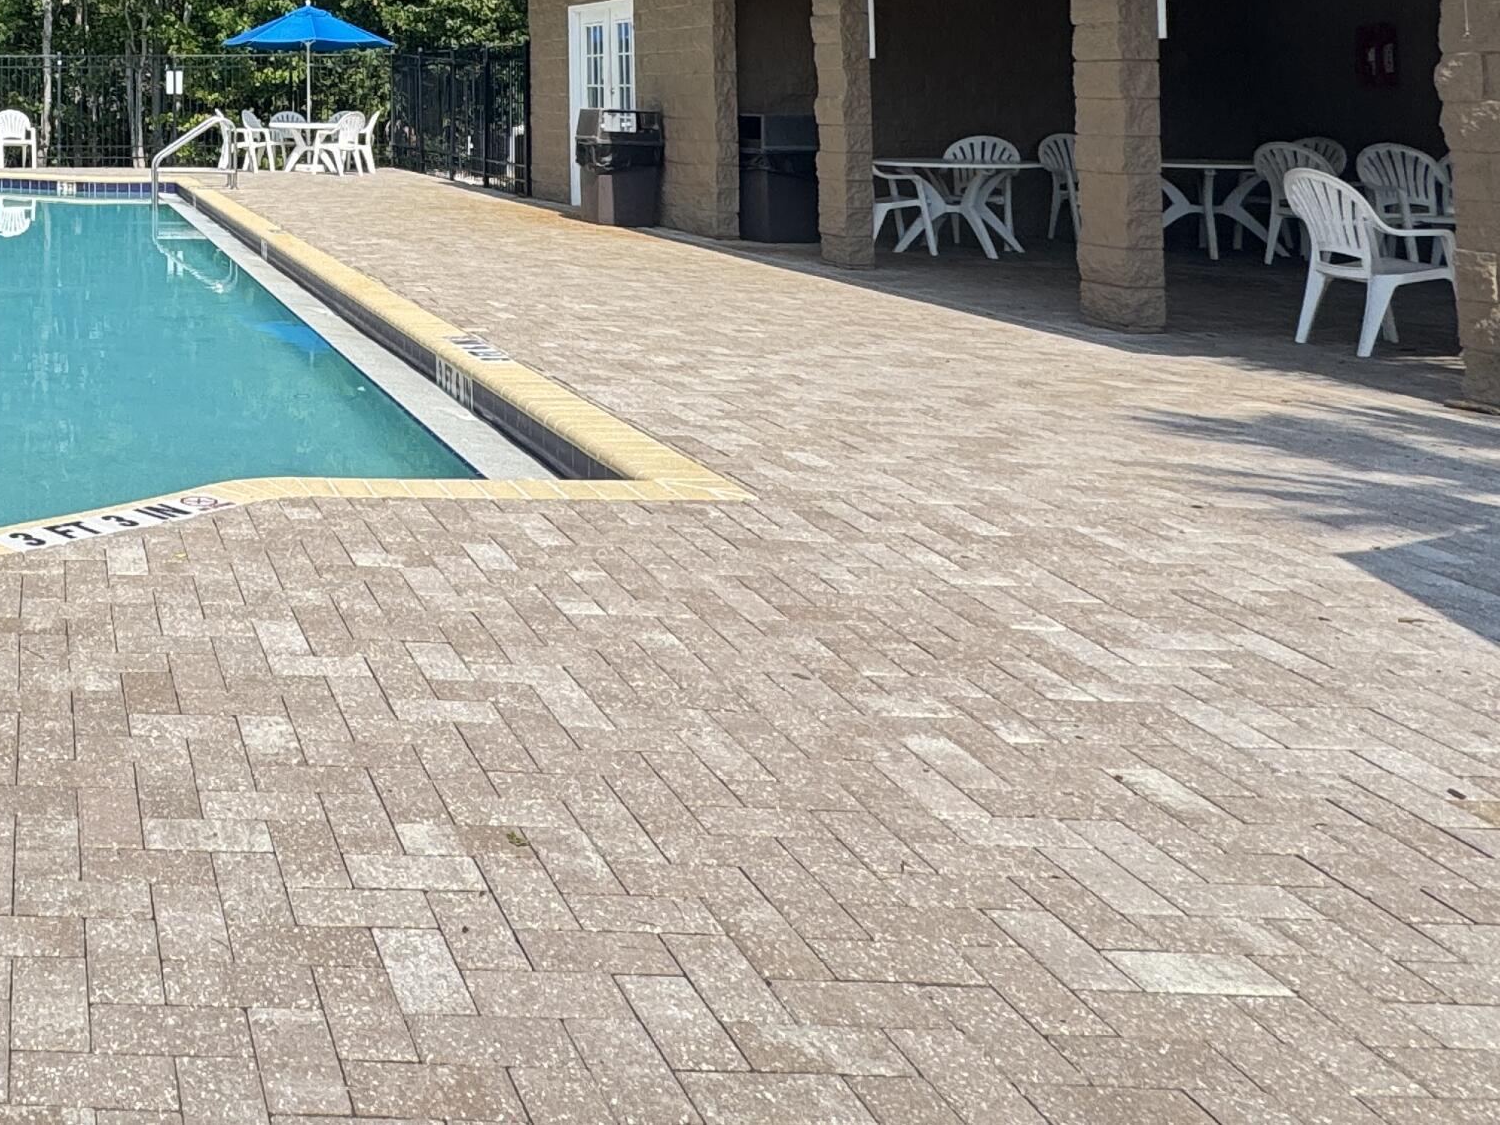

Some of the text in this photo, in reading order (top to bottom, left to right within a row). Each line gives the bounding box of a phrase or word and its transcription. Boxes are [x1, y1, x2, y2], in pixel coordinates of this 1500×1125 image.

[9, 503, 192, 546] 3 FT 3 IN
